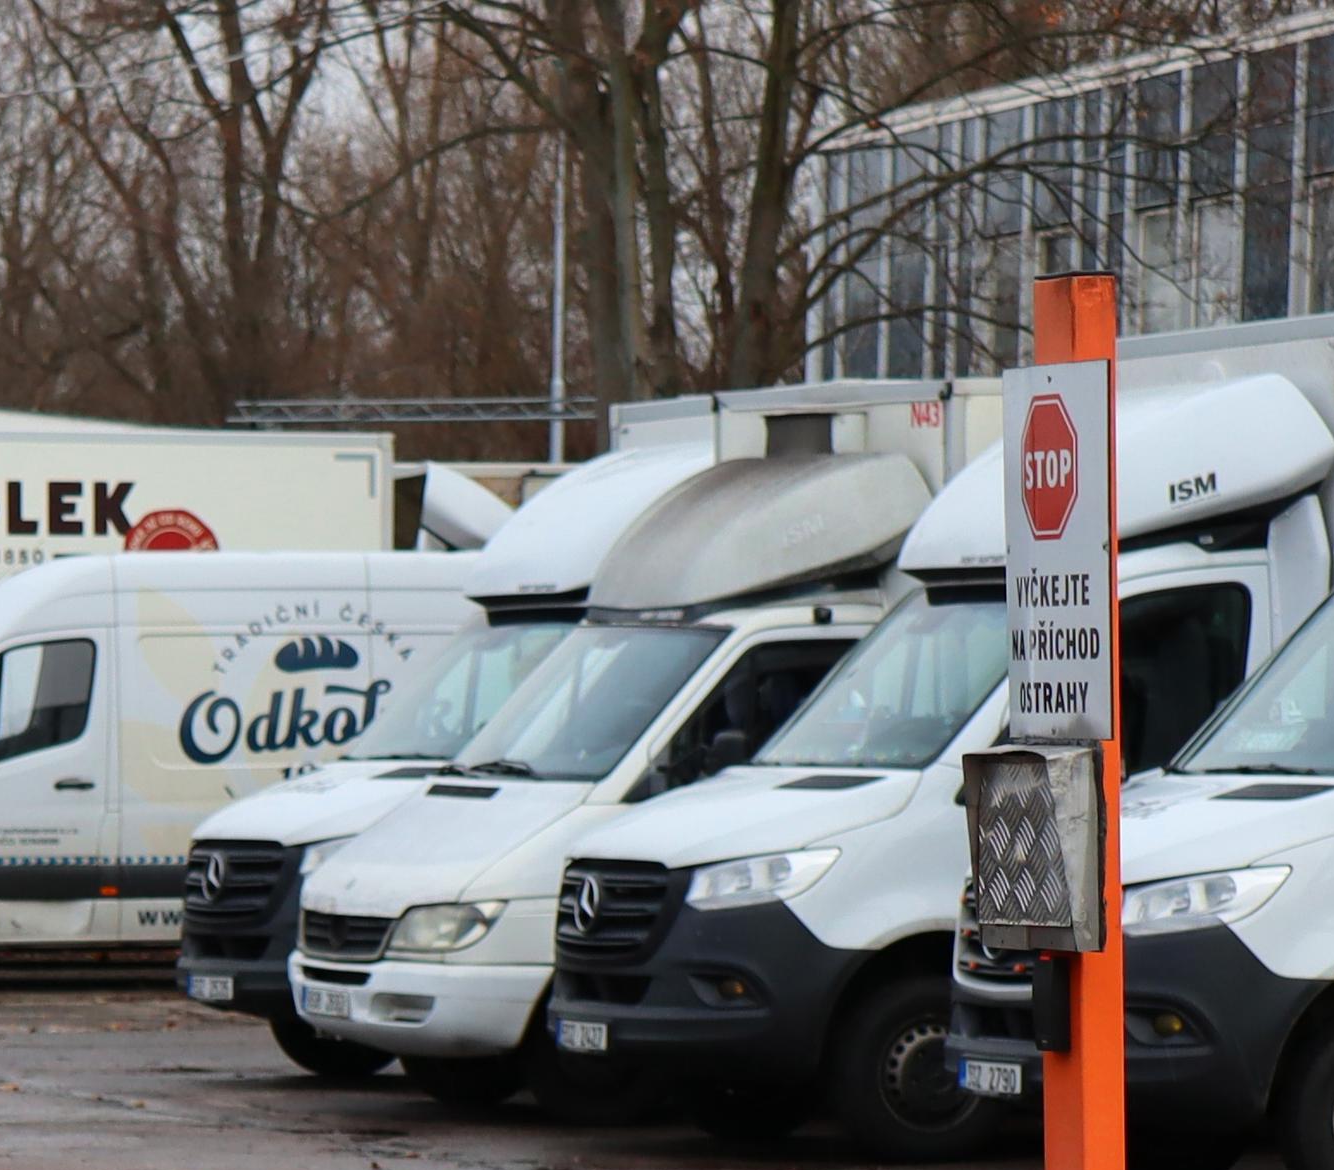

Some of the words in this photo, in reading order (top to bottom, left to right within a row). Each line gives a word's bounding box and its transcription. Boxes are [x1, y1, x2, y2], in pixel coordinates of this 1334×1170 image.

[1024, 449, 1072, 491] STOP
[1170, 473, 1217, 503] ISM
[1016, 569, 1090, 608] VYČKEJTE
[1012, 630, 1026, 661] NA
[1029, 620, 1100, 661] PŘÍCHOD
[1020, 681, 1089, 714] OSTRAHY
[179, 680, 392, 765] Odkol
